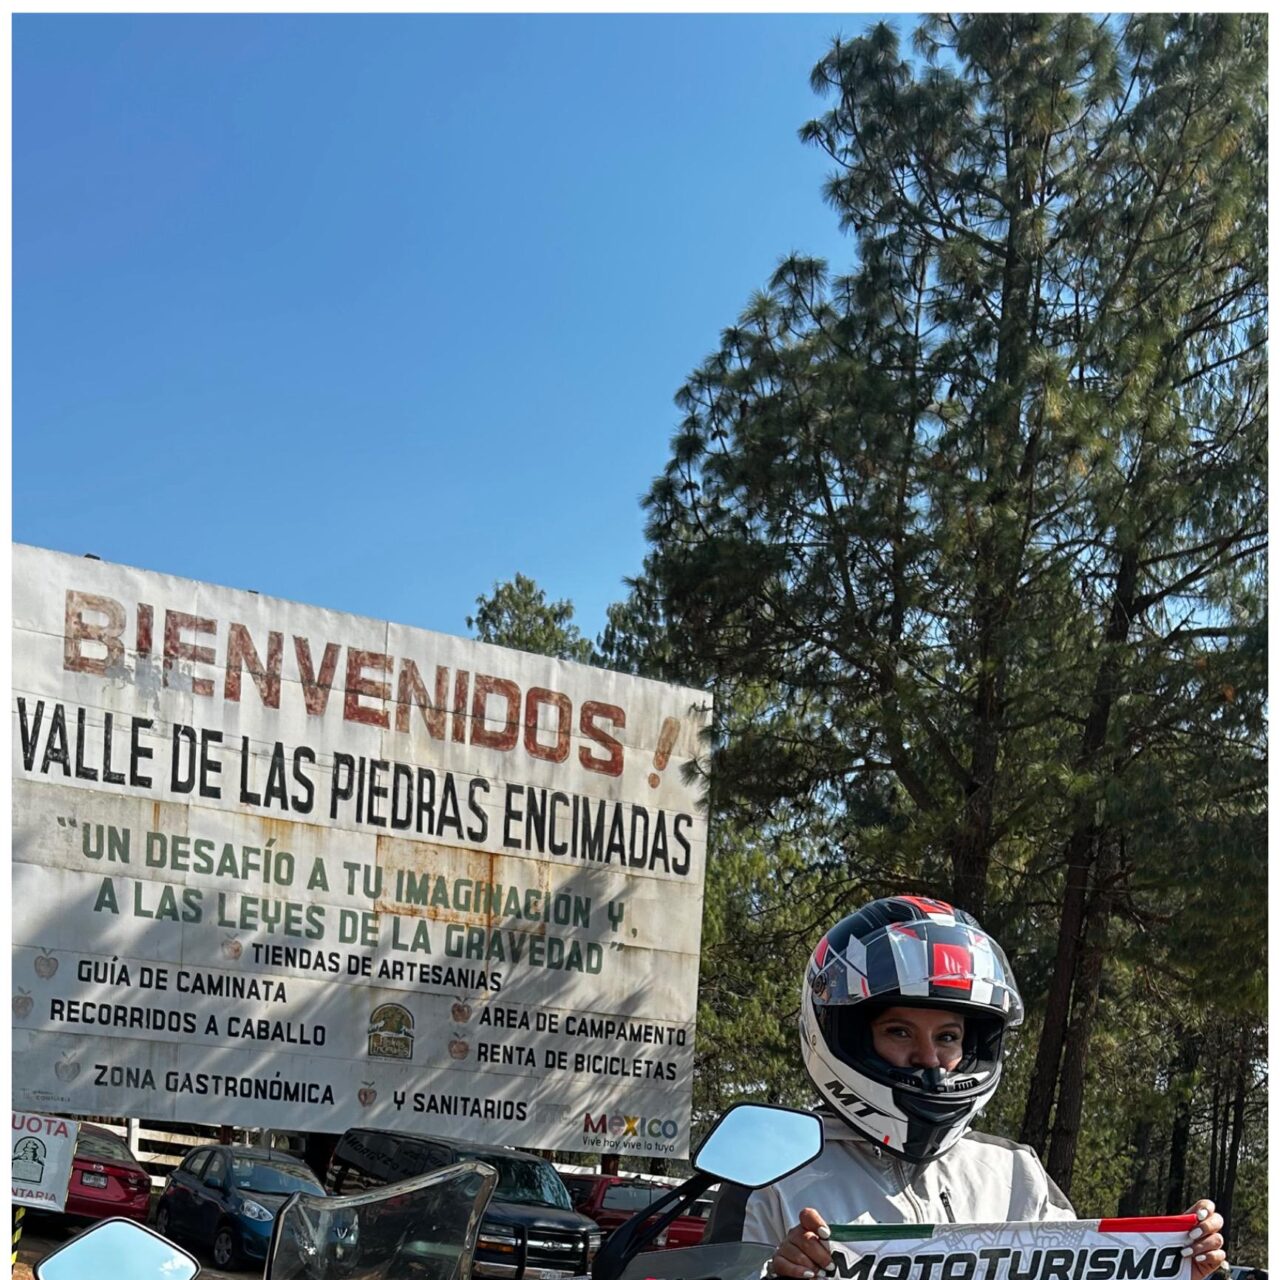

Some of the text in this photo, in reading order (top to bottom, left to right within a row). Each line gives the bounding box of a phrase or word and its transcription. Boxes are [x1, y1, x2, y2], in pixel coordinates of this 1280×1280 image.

[63, 588, 626, 778] BIENVENIDOS
[17, 697, 692, 876] VALLE DE LAS PIEDRAS ENCIMADAS
[145, 832, 295, 887] DESAFÍO
[307, 856, 330, 892] A
[343, 861, 384, 900] TU
[395, 869, 591, 930] IMAGINACIÓN
[94, 877, 119, 915] A
[133, 883, 203, 924] LAS
[217, 893, 325, 941] LEYES
[339, 909, 380, 949] DE
[391, 914, 432, 955] LA
[77, 957, 288, 1004] GUÍA DE CAMINATA
[251, 943, 502, 993] TIENDAS DE ARTESANIAS
[50, 1000, 327, 1047] RECORRIDOS A CABALLO
[535, 1010, 559, 1032] DE
[564, 1016, 687, 1048] CAMPAMENTO
[93, 1064, 336, 1107] ZONA GASTRONÓMICA
[476, 1043, 677, 1082] RENTA DE BICICLETAS
[392, 1091, 406, 1113] Y
[413, 1092, 528, 1123] SANITARIOS
[824, 1080, 891, 1118] MT
